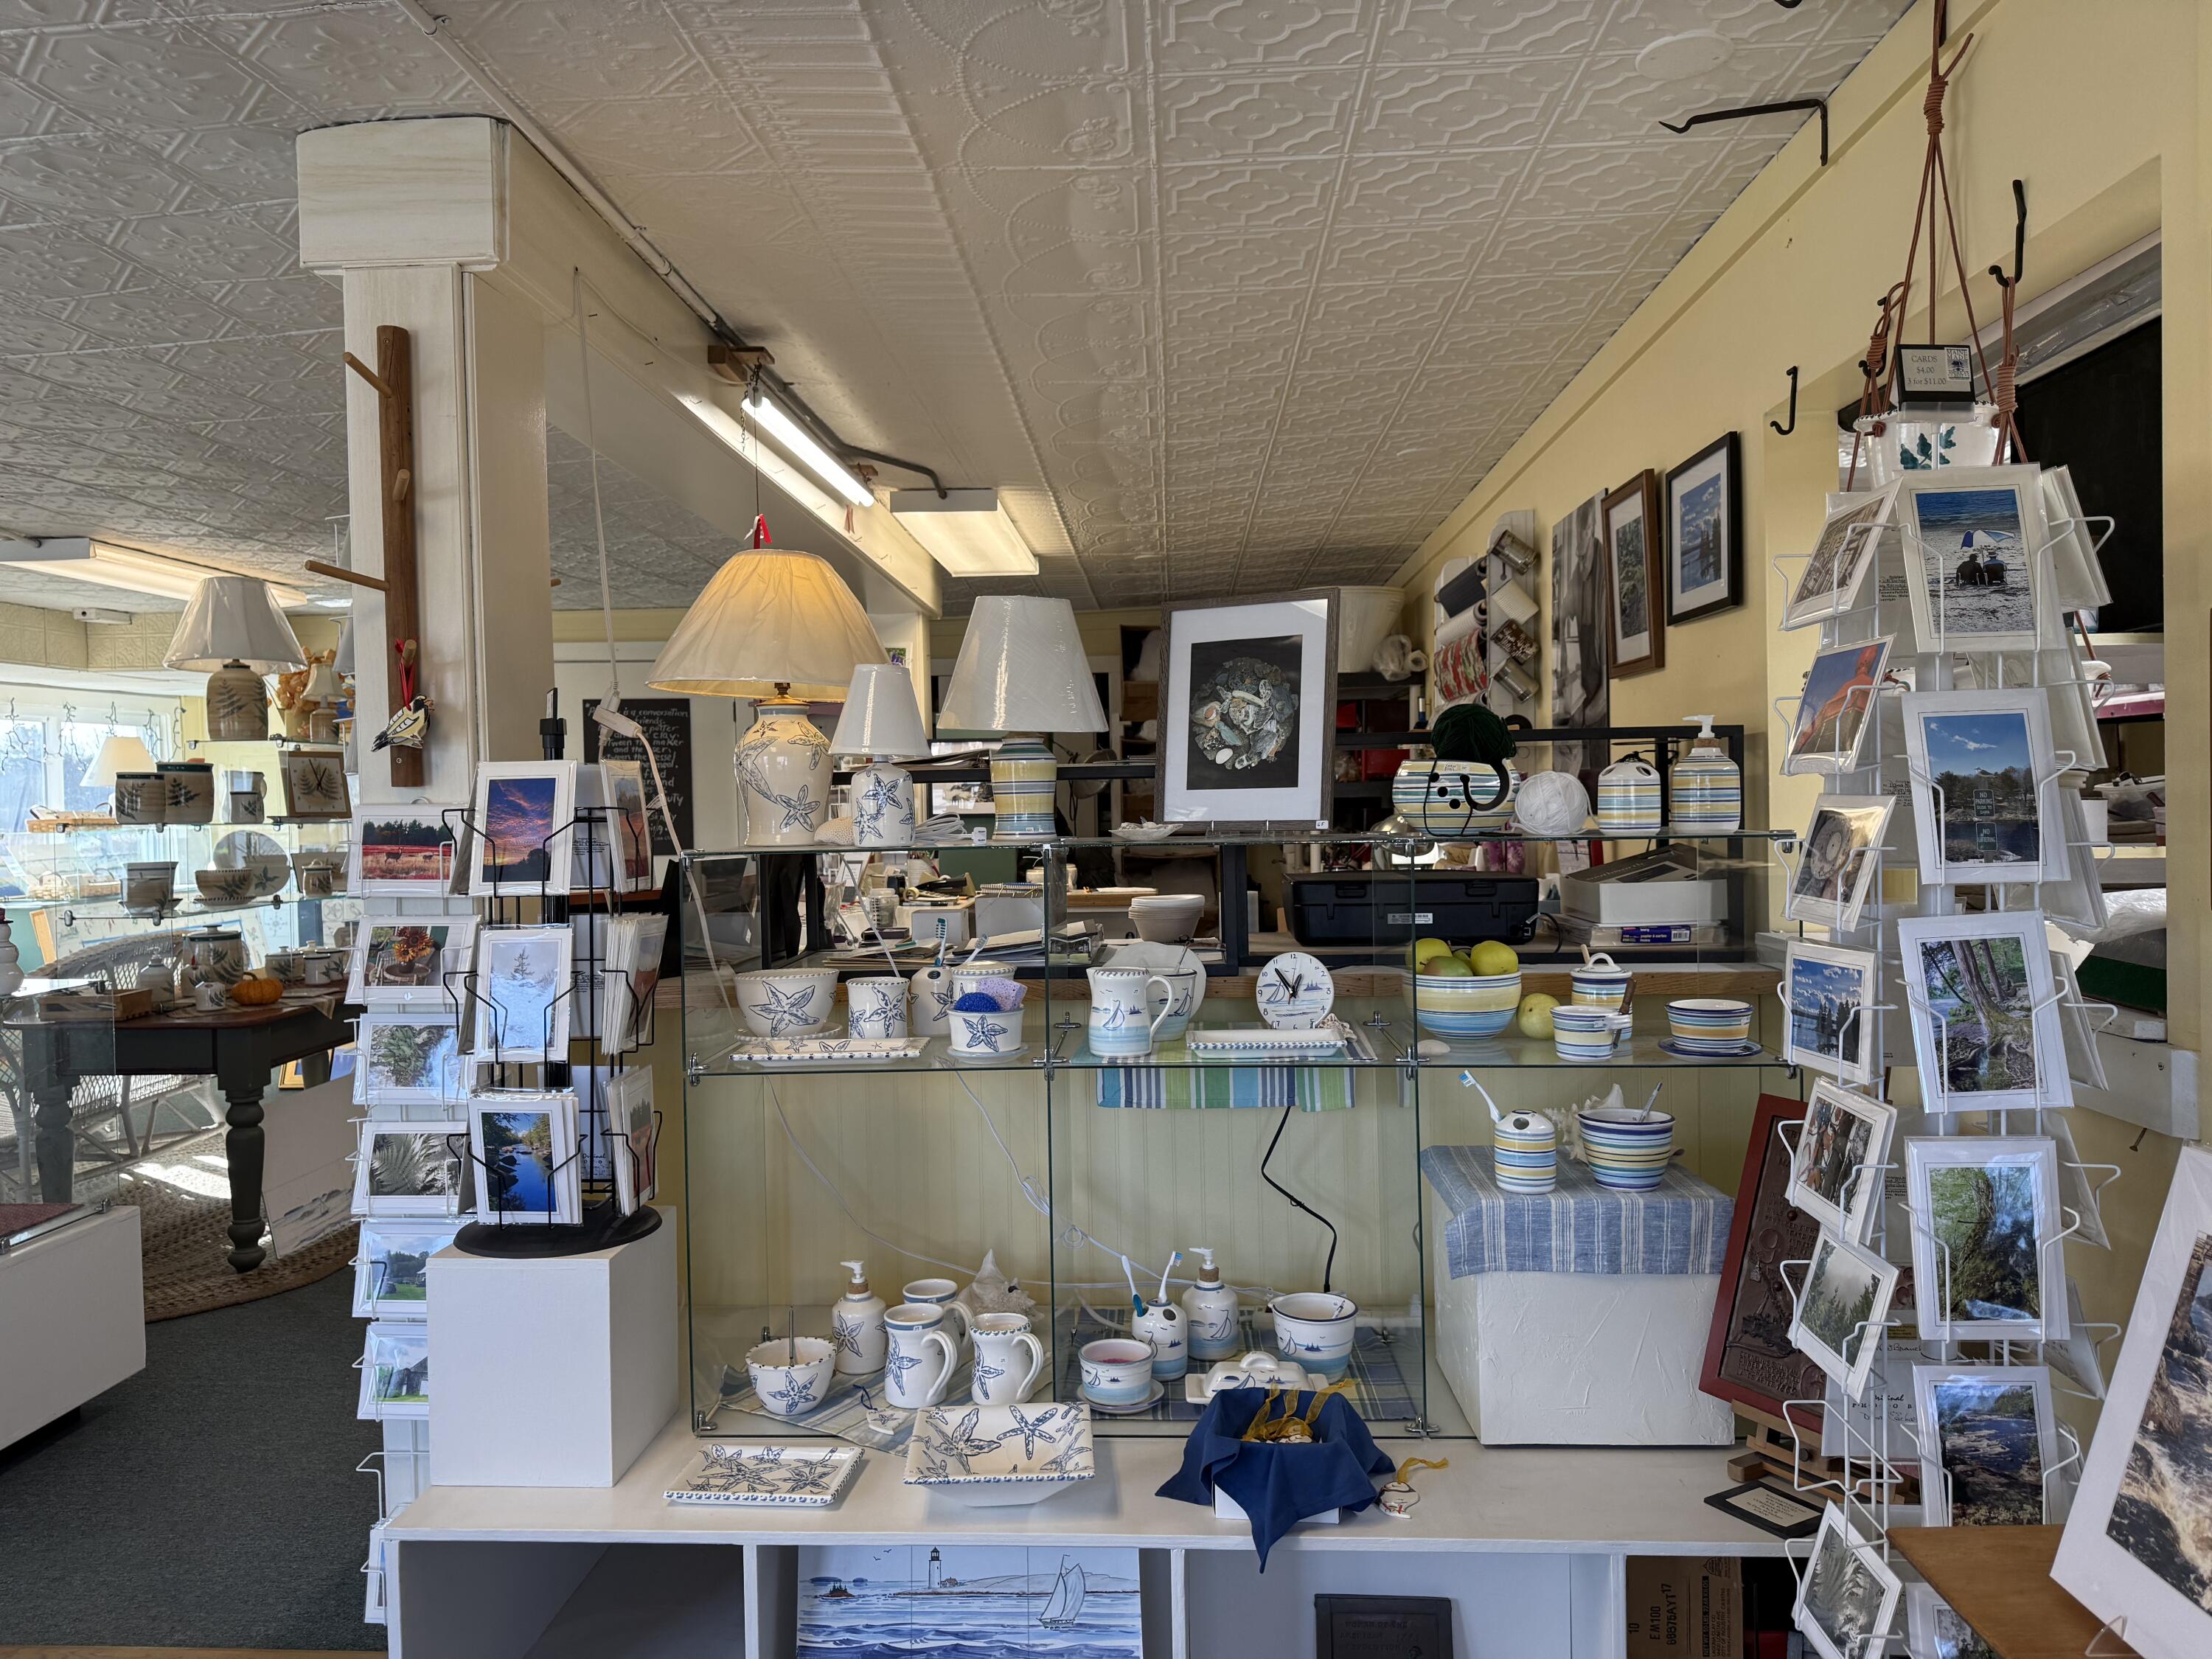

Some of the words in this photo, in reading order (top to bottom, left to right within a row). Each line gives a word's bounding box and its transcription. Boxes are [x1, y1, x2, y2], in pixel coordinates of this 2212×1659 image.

[1257, 990, 1263, 998] 9
[1263, 1008, 1268, 1016] 8
[1320, 1005, 1327, 1014] 4
[1628, 1622, 1640, 1634] 10
